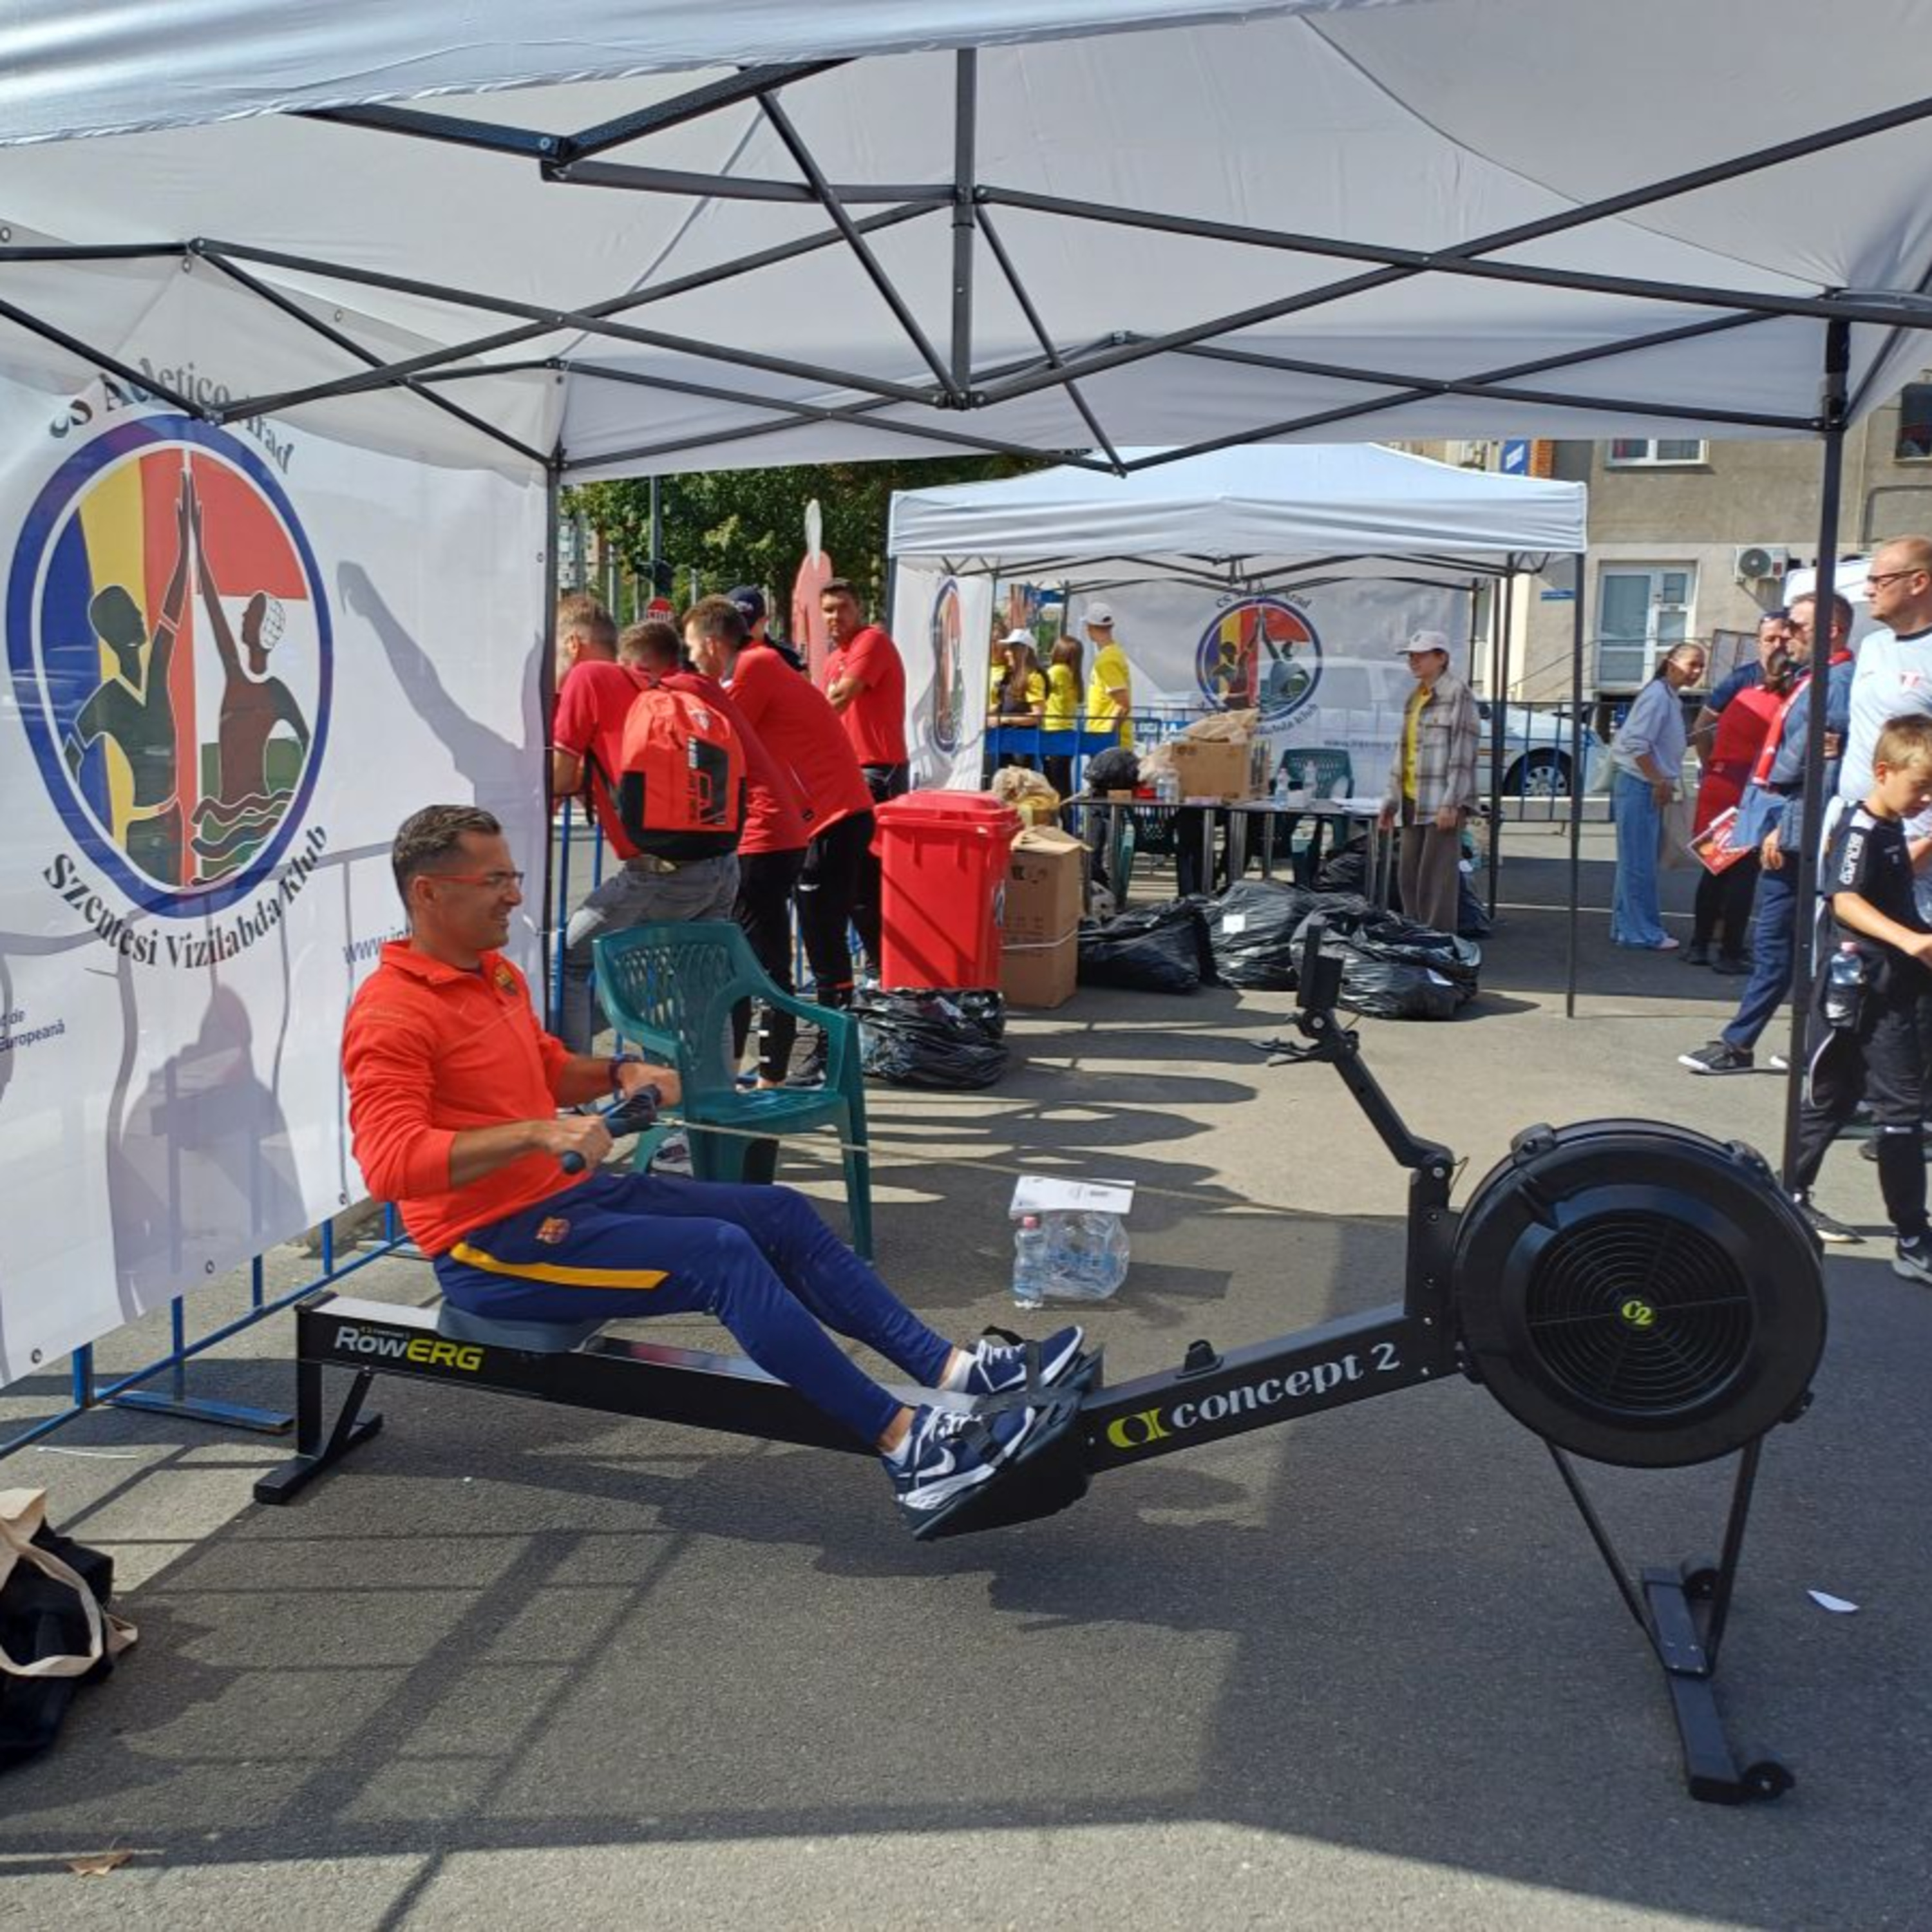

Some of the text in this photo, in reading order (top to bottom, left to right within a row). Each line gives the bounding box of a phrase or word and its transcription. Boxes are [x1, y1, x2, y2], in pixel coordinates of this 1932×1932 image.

[237, 395, 294, 475] rad
[43, 853, 158, 965] Szentesi
[279, 826, 327, 904] Klub
[1171, 1354, 1364, 1429] concept
[1370, 1342, 1401, 1371] 2
